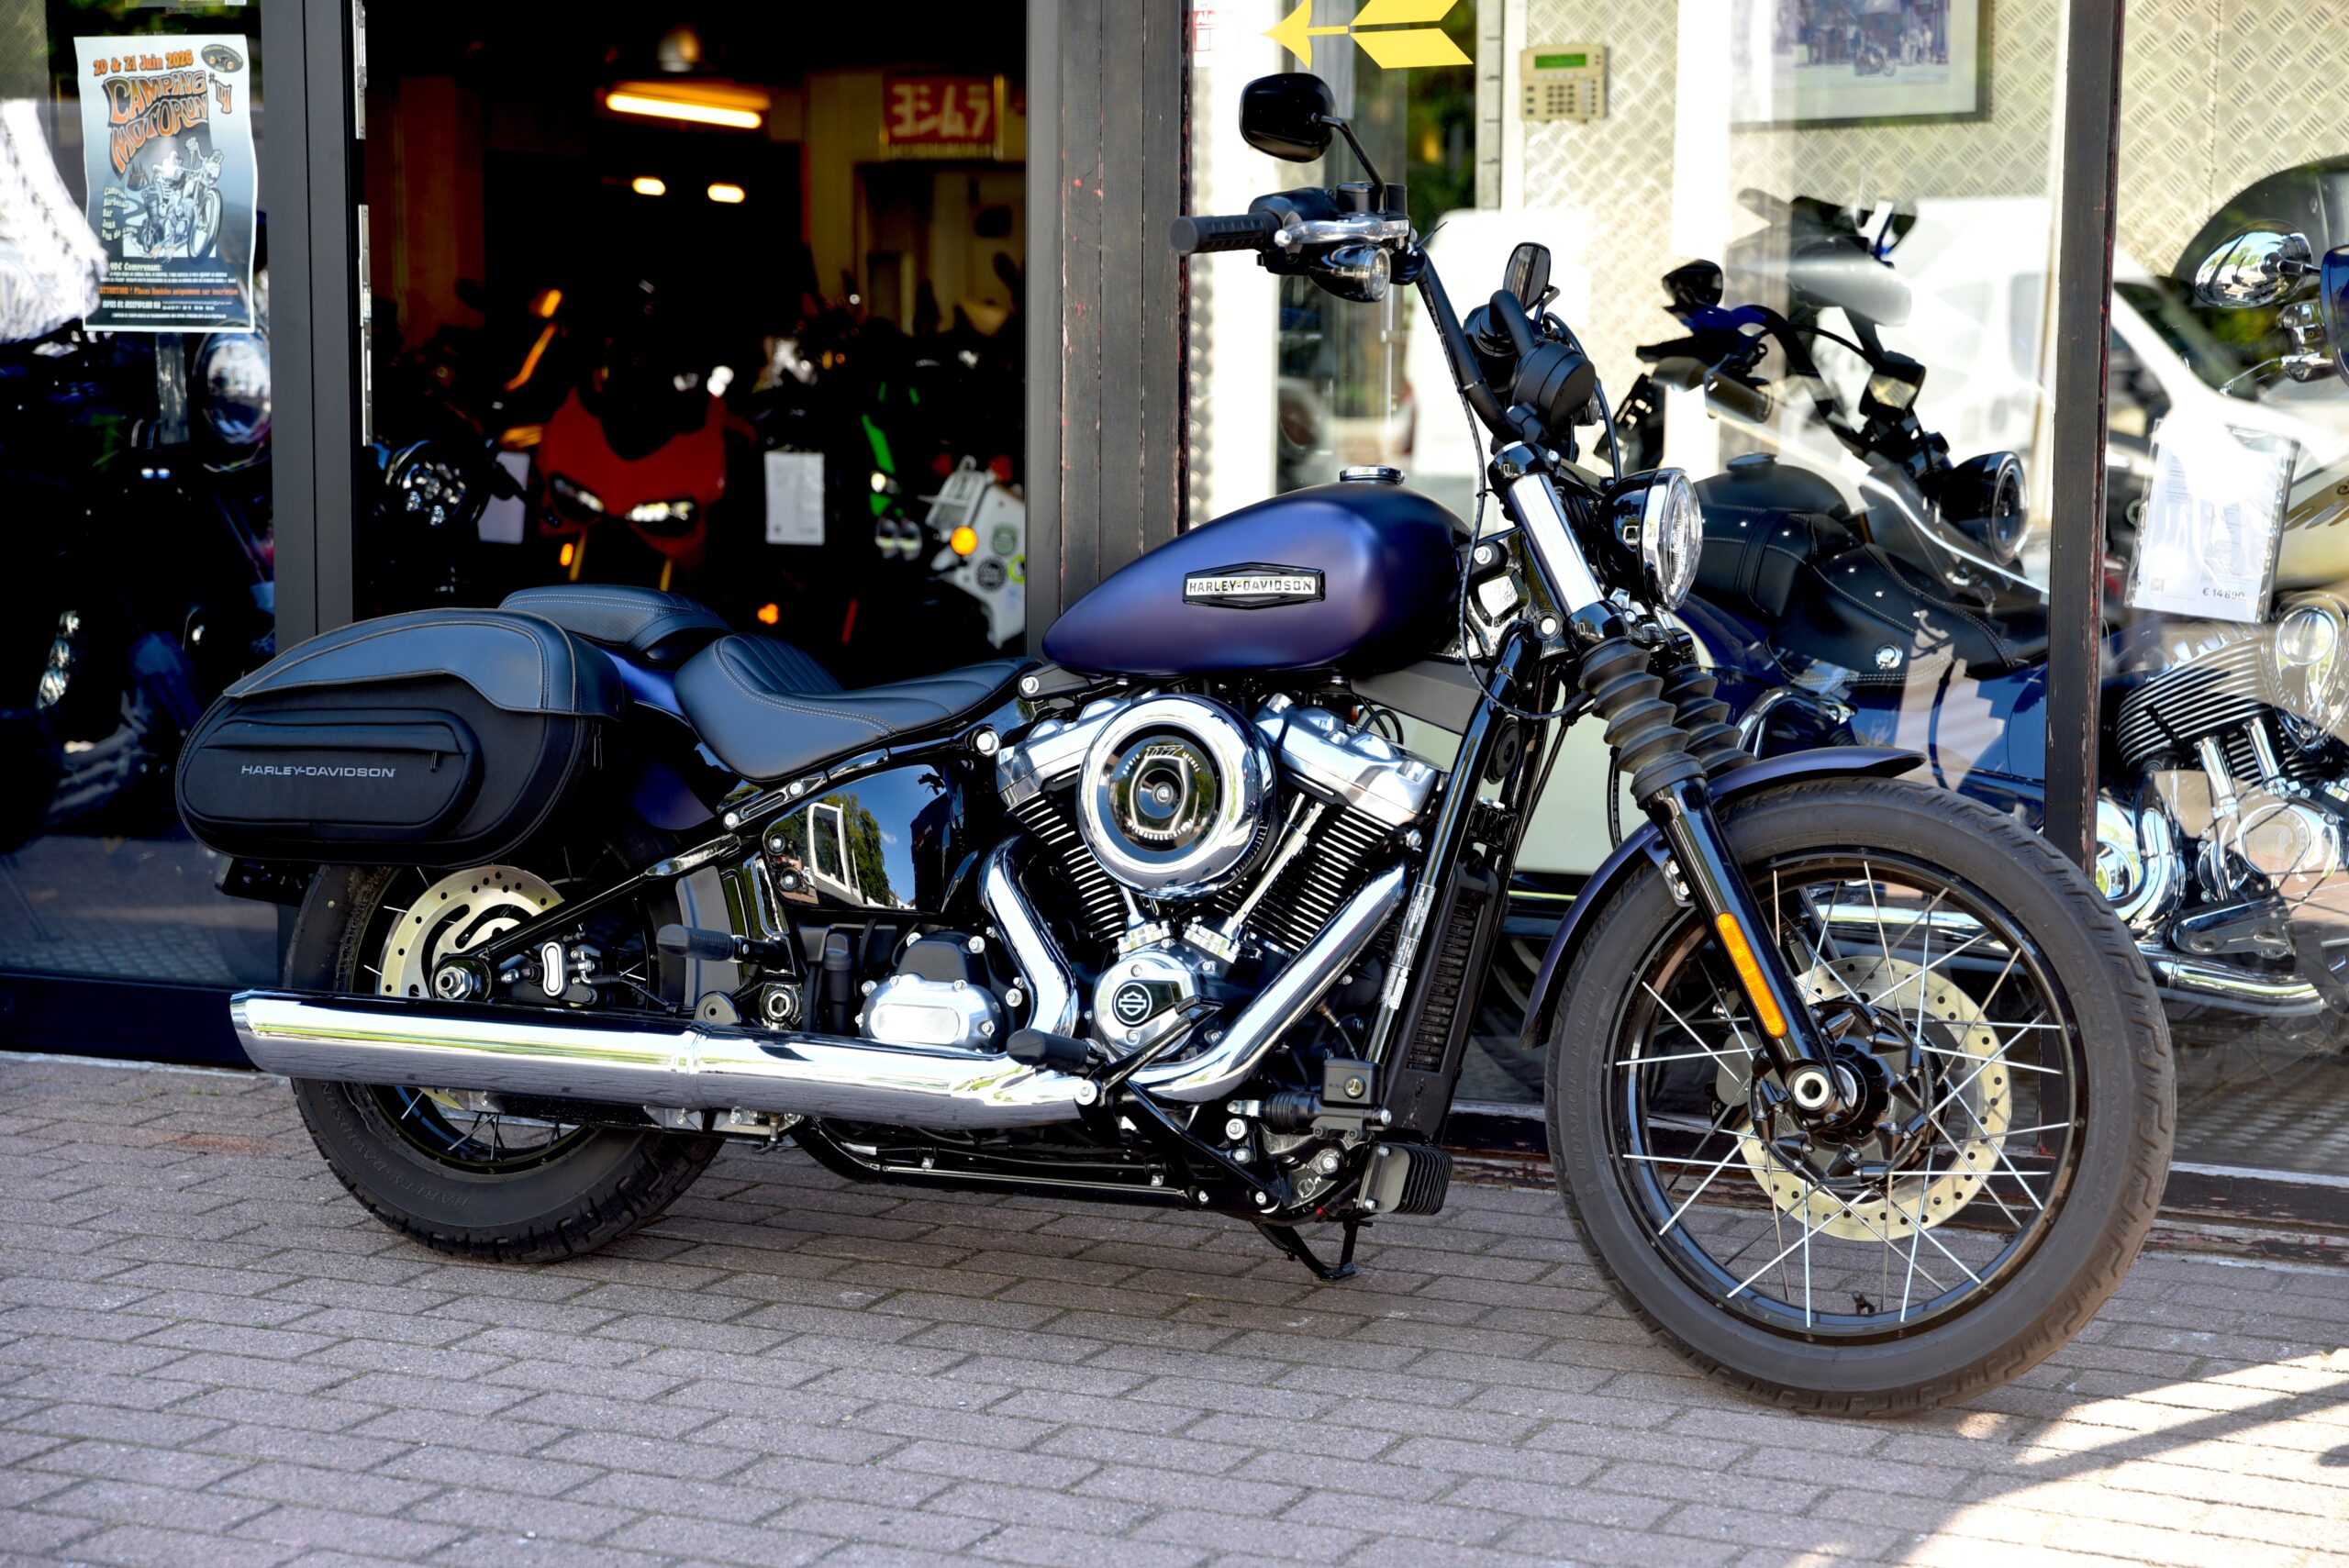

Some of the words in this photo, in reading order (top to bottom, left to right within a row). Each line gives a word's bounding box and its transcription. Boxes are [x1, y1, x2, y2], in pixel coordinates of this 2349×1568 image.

[94, 59, 107, 75] 20
[111, 57, 121, 72] &
[124, 55, 137, 72] 21
[139, 53, 163, 71] Juin
[166, 49, 194, 70] 2026
[893, 83, 989, 138] ヨシムラ
[110, 94, 208, 174] MOTORUN
[1189, 580, 1312, 593] HARLEY-DAVIDSON
[240, 764, 396, 778] HARLEY-DAVIDSON
